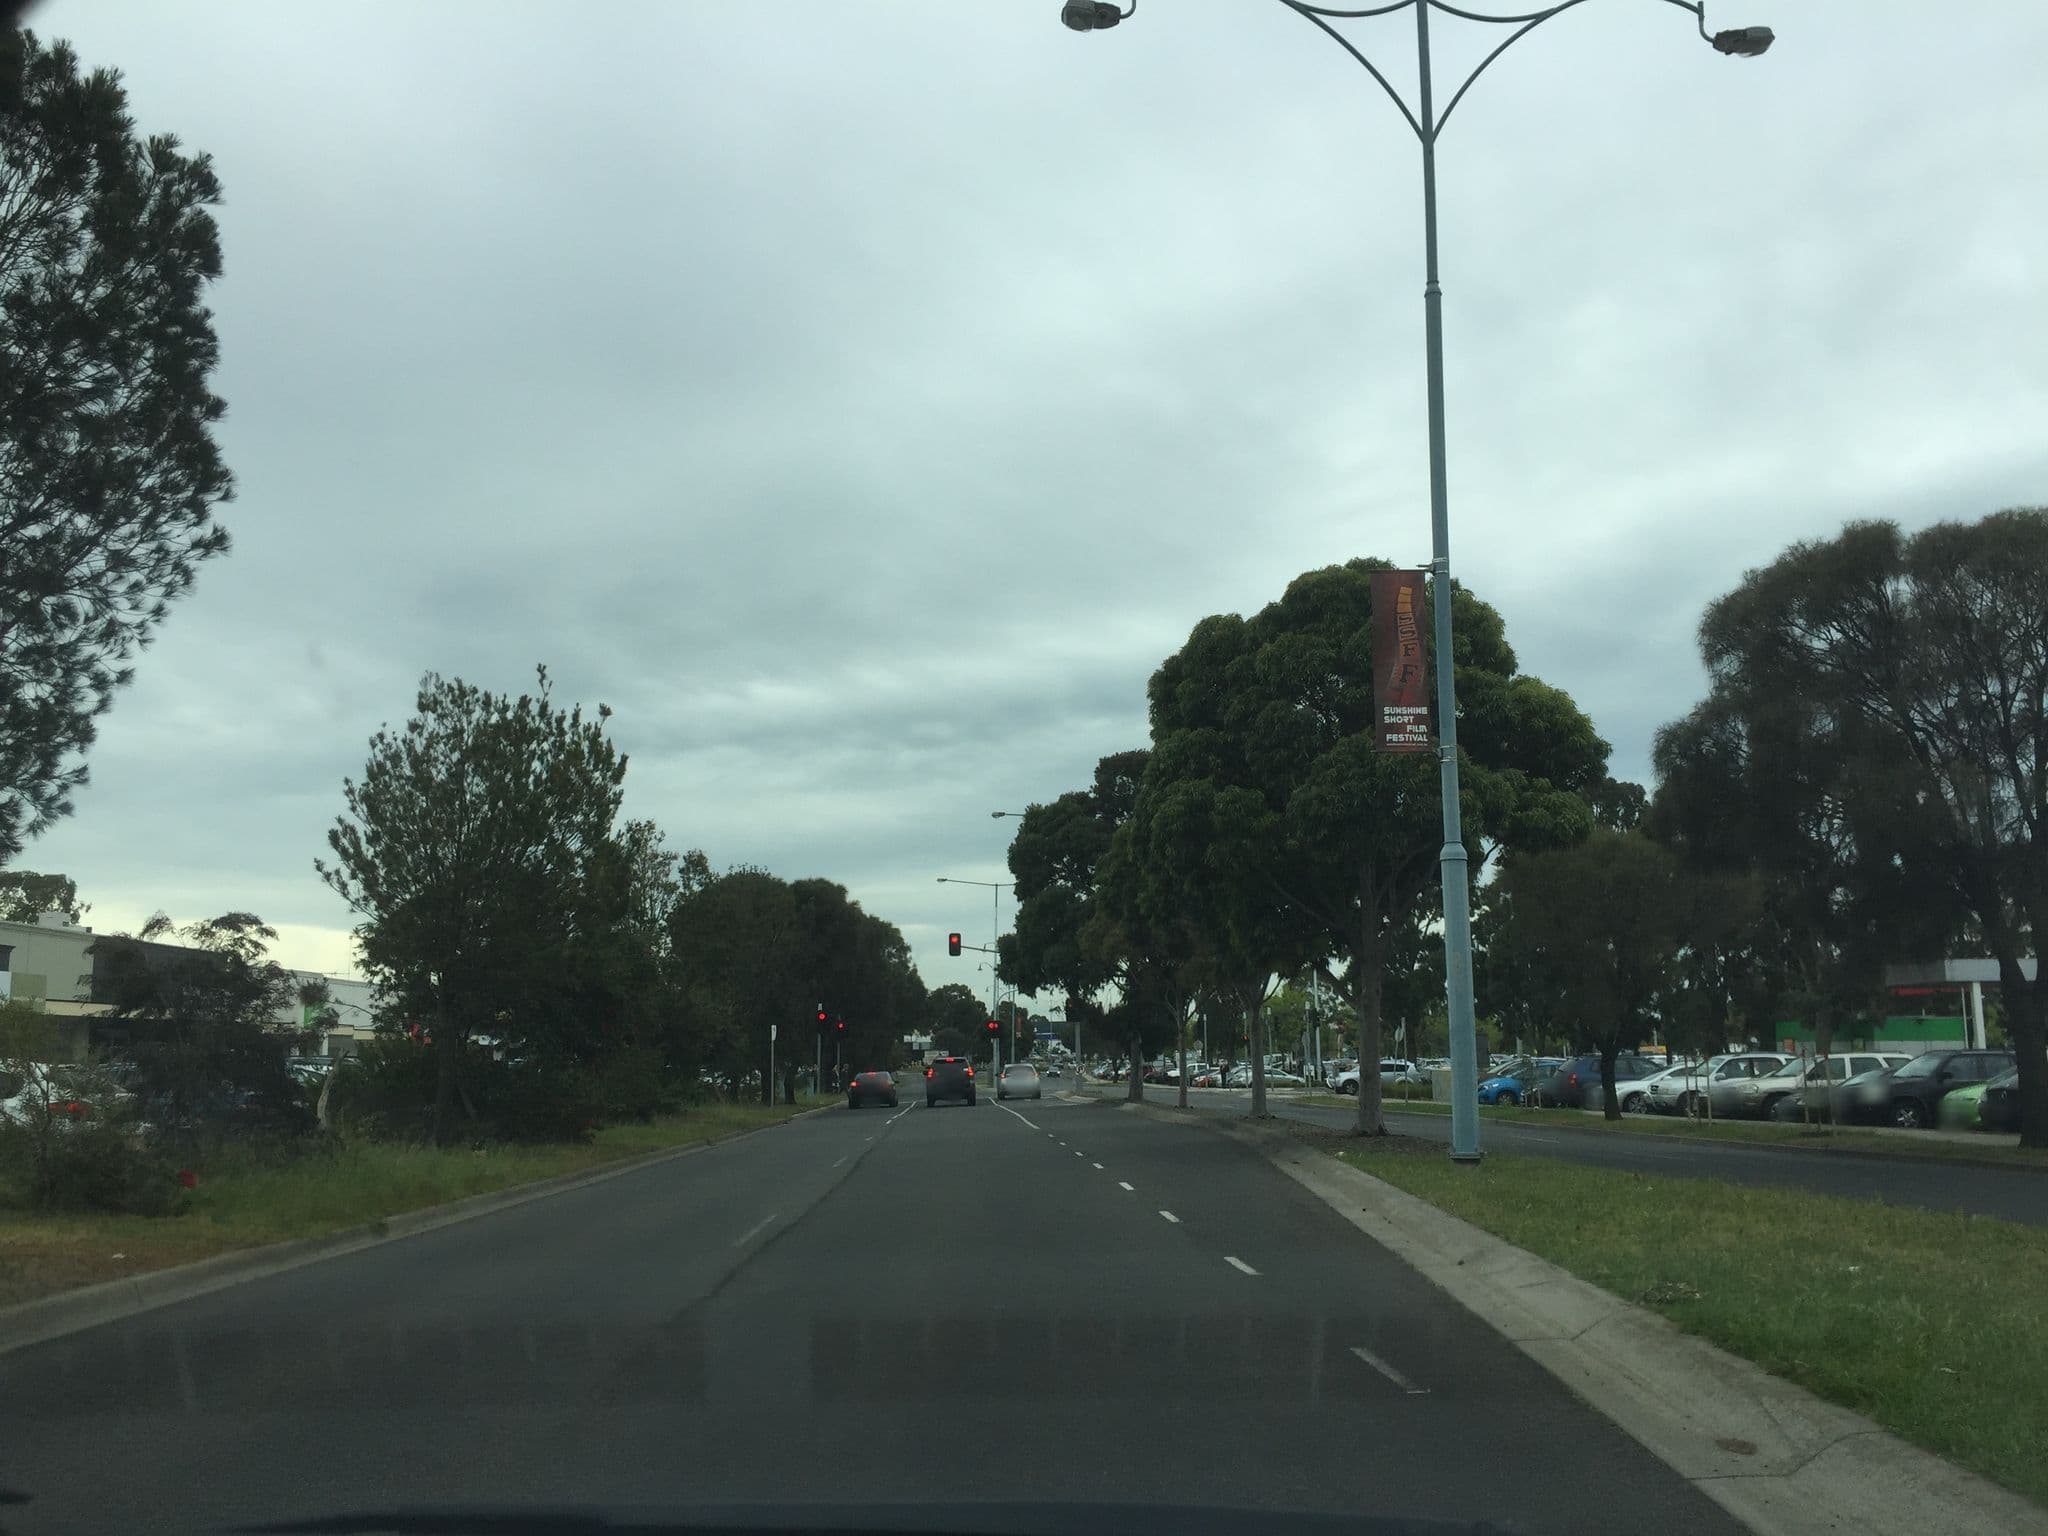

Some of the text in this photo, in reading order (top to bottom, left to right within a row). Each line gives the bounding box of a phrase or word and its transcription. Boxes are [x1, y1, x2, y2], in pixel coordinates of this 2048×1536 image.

[1383, 706, 1428, 715] SUNSHINE
[1383, 715, 1414, 724] SHORT
[1406, 724, 1428, 733] FILM
[1386, 733, 1429, 742] FESTIVAL
